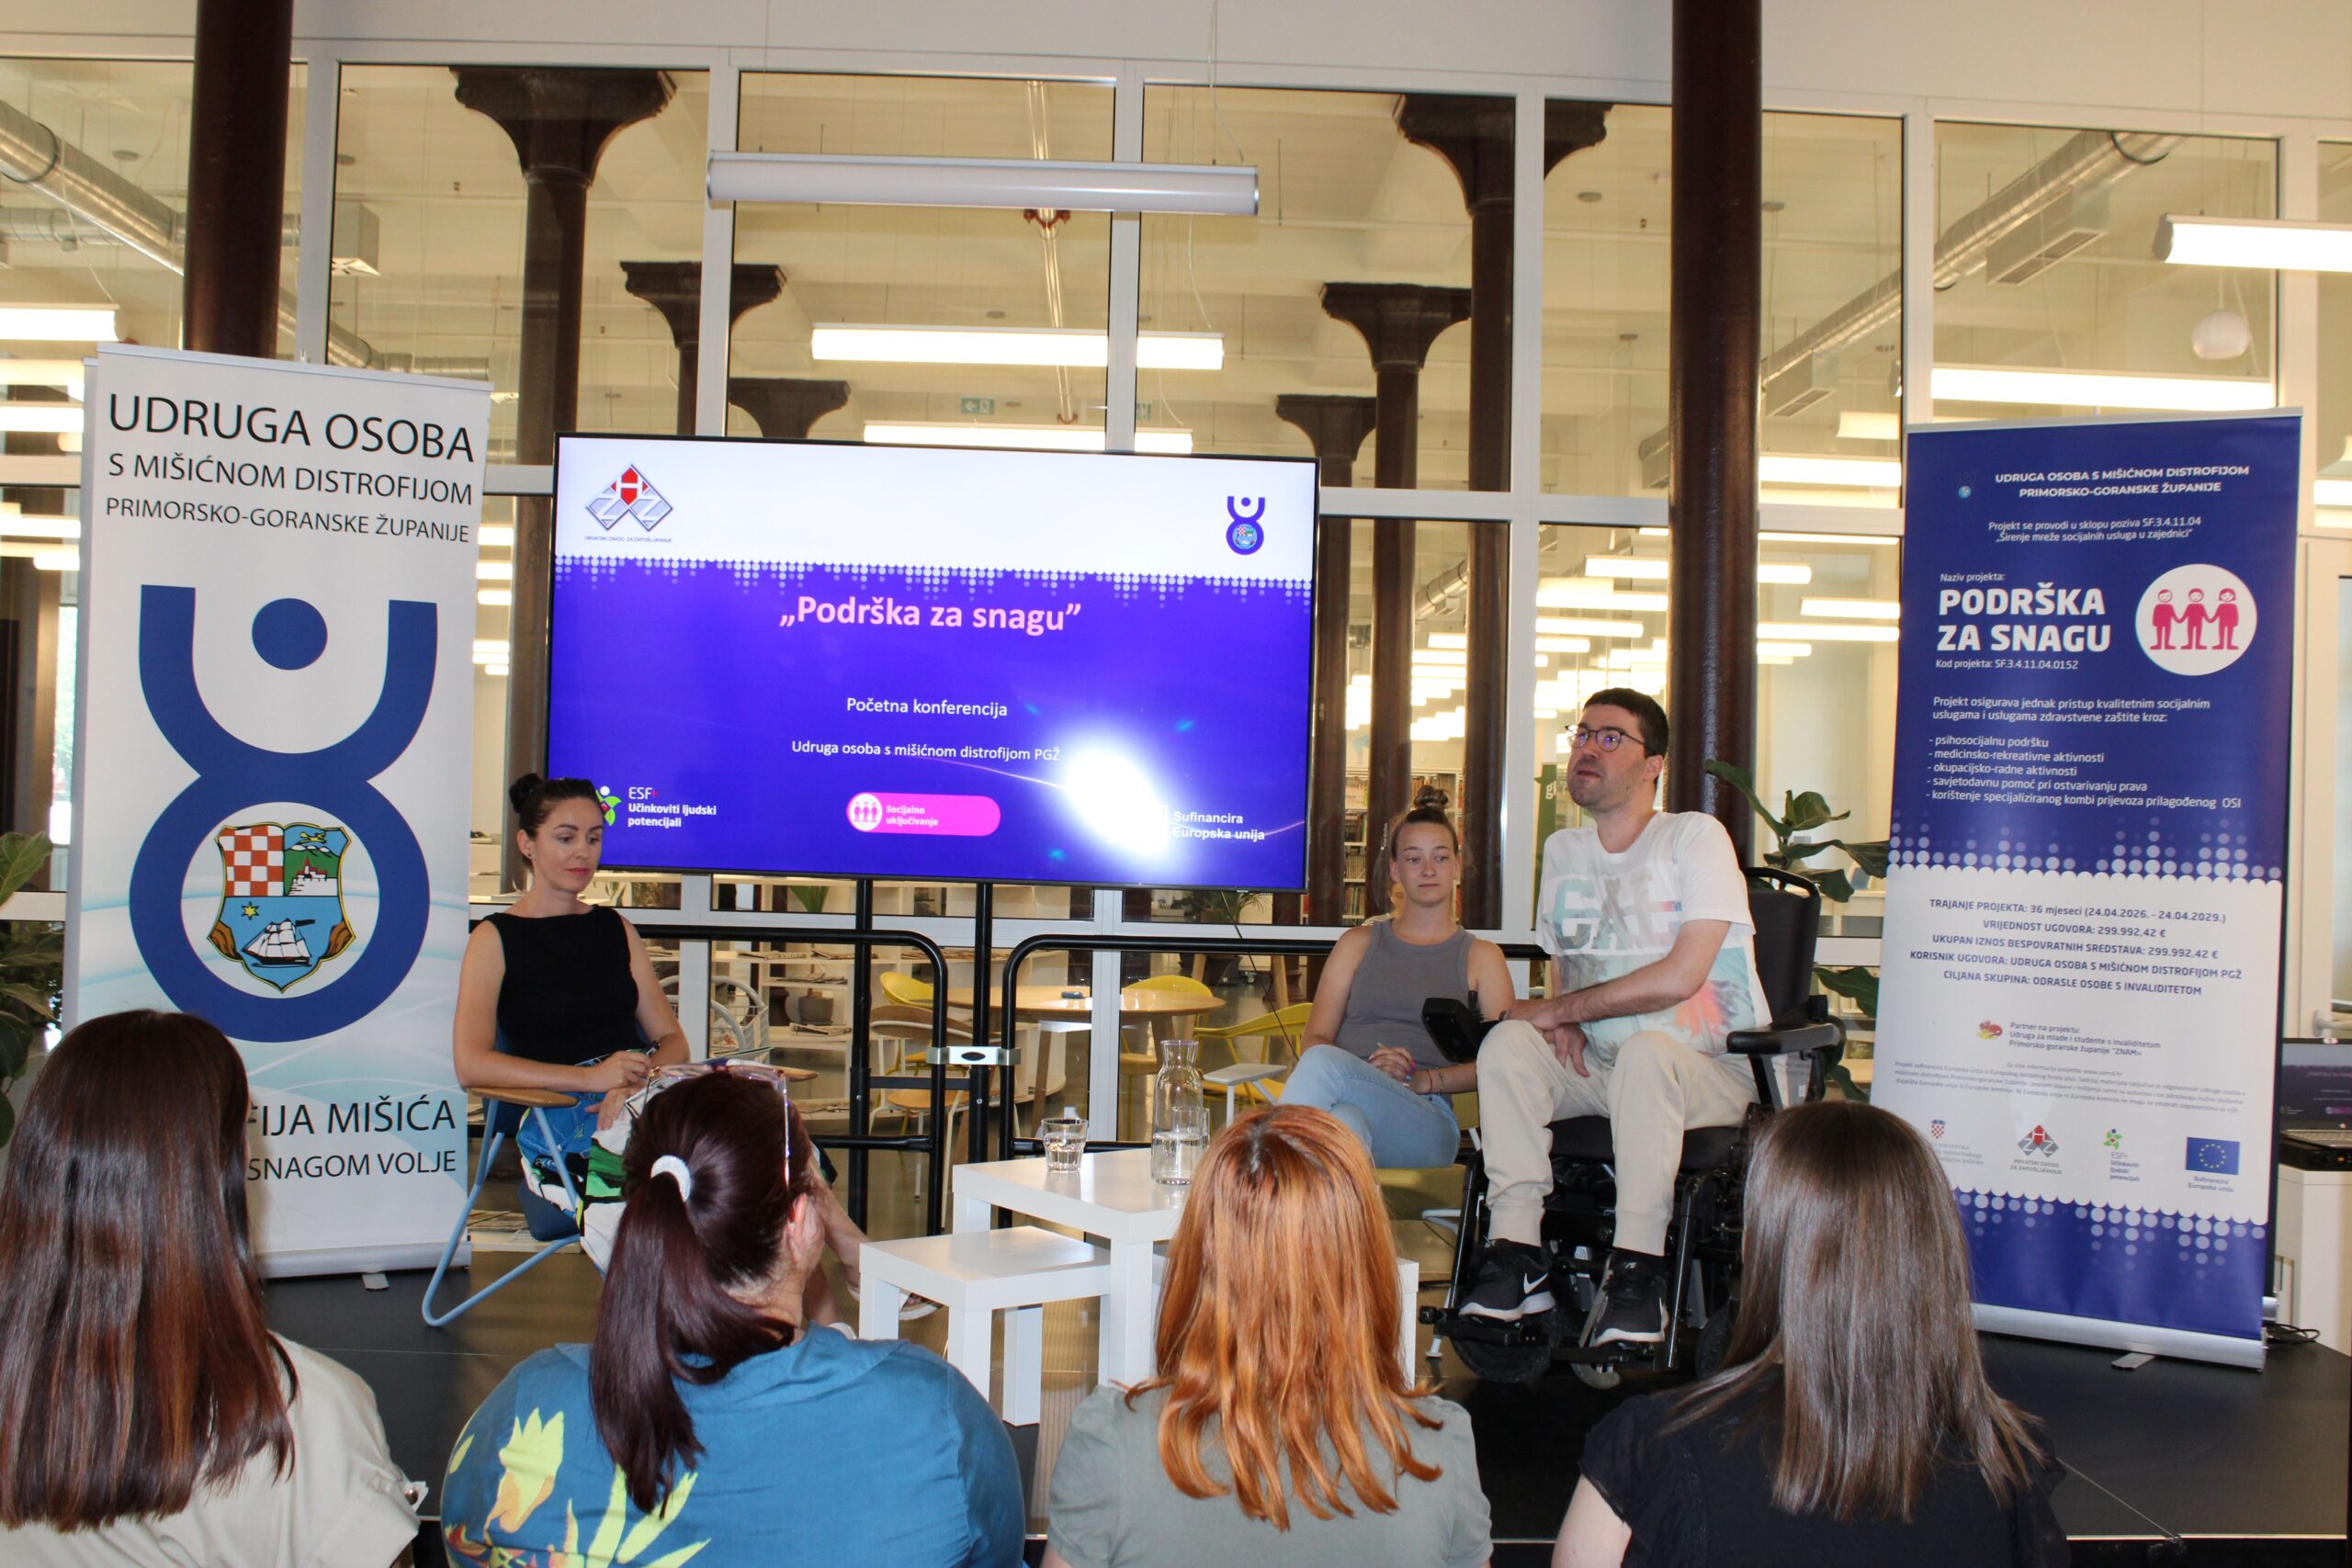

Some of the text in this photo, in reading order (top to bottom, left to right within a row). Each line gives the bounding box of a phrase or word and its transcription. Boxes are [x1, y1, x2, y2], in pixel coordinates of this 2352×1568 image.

[109, 394, 475, 462] UDRUGA OSOBA
[108, 452, 471, 505] S MIŠIĆNOM DISTROFIJOM
[1995, 466, 2249, 482] UDRUGA OSOBA S MIŠIĆNOM DISTROFIJOM
[2019, 482, 2221, 496] PRIMORSKO-GORANSKE ŽUPANIJE
[106, 497, 469, 543] PRIMORSKO-GORANSKE ŽUPANIJE
[1988, 521, 2020, 532] Projekt
[2034, 521, 2068, 530] provodi
[2078, 520, 2109, 529] sklopu
[2110, 519, 2140, 529] poziva
[2031, 532, 2060, 541] mreže
[2061, 531, 2104, 541] socijalnih
[2106, 531, 2137, 540] usluga
[1940, 573, 2005, 582] Naziv projekta:
[1939, 582, 2105, 615] PODRŠKA
[930, 606, 962, 626] za
[1937, 625, 2110, 651] ZA SNAGU
[1935, 659, 1952, 667] Kod
[1953, 659, 1992, 668] projekta:
[847, 697, 1008, 719] Početna konferencija
[1933, 696, 2210, 710] Projekt osigurava jednak pristup kvalitetnim socijalnim
[1932, 709, 2167, 722] uslugama i uslugama zdravstvene zaštite kroz:
[1935, 735, 2048, 747] psihosocijalnu podršku
[792, 741, 1060, 761] Udruga osoba s mišićnom distrofijom PGŽ
[1934, 749, 2104, 762] medicinsko-rekreativne aktivnosti
[1933, 763, 2077, 775] okupacijsko-radne aktivnosti
[1932, 777, 2147, 792] savjetodavnu pomoć pri ostvarivanju prava
[628, 787, 658, 800] ESF+
[1932, 790, 2241, 808] korištenje specijaliziranog kombi prijevoza prilagođenog OSI
[628, 803, 717, 816] Učinkoviti ljudski
[886, 805, 925, 816] Socijalno
[628, 817, 682, 829] potencijali
[886, 816, 939, 828] uključivanje
[1173, 811, 1244, 824] Sufinancira
[1173, 827, 1265, 842] Europska unija
[1929, 899, 2226, 922] TRAJANJE PROJEKTA: 36 mjeseci (24.04.2026. 24.04.2029.)
[1983, 920, 2165, 937] VRIJEDNOST UGOVORA: 299.992,42 €
[1932, 934, 2218, 959] UKUPAN IZNOS BESPOVRATNIH SREDSTAVA: 299.992,42 €
[1910, 951, 2242, 979] KORISNIK UGOVORA: UDRUGA OSOBA S MIŠIĆNOM DISTROFIJOM PGŽ
[1943, 970, 2201, 994] CILJANA SKUPINA: ODRASLE OSOBE S INVALIDITETOM
[2008, 1039, 2078, 1050] Primorsko-goranske
[2080, 1045, 2110, 1054] županije
[2009, 1031, 2035, 1040] Udruga
[2112, 1040, 2161, 1048] invaliditetom
[327, 1094, 457, 1134] MIŠIĆA
[247, 1150, 457, 1181] SNAGOM VOLJE
